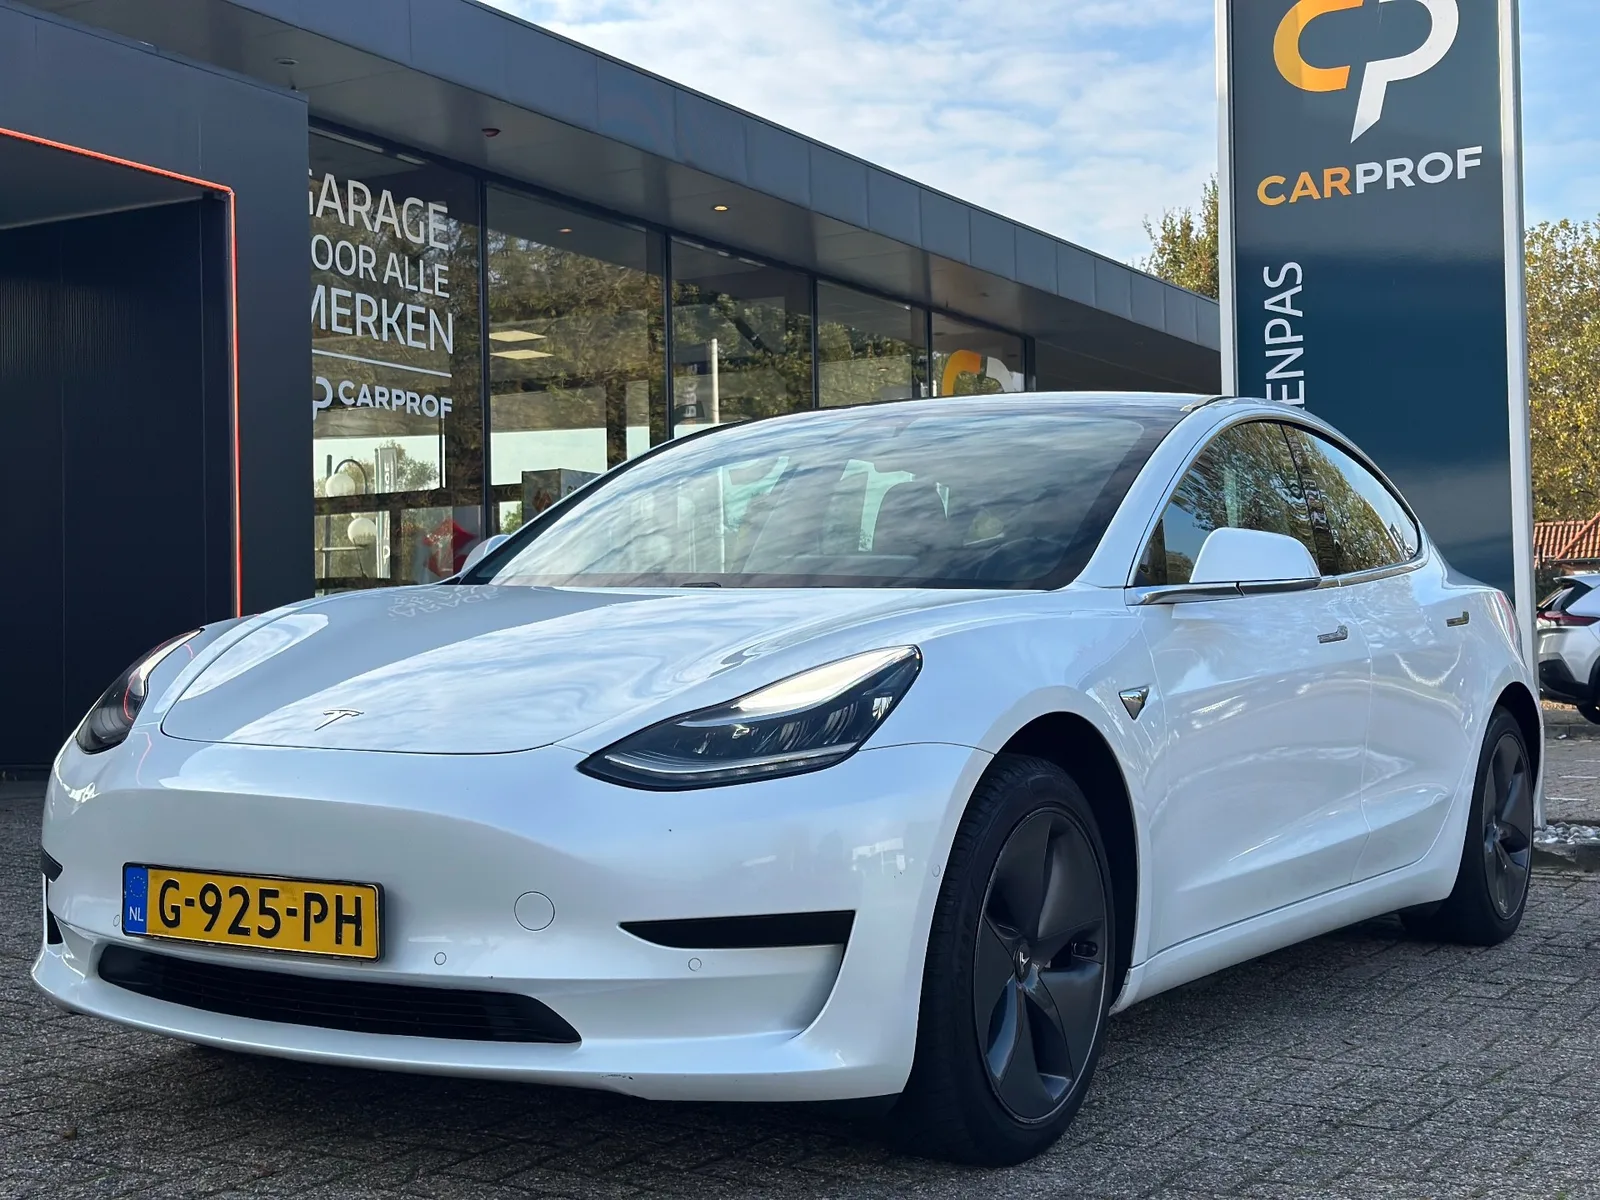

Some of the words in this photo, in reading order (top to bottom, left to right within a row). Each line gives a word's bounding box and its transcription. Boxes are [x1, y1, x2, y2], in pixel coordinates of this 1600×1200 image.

[1257, 146, 1483, 206] CARPROF
[309, 168, 449, 251] ARAGE
[383, 252, 450, 299] ALLE
[1263, 261, 1305, 411] ENPAS
[338, 380, 453, 419] CARPROF
[129, 906, 144, 922] NL
[159, 878, 362, 947] G-925-PH
